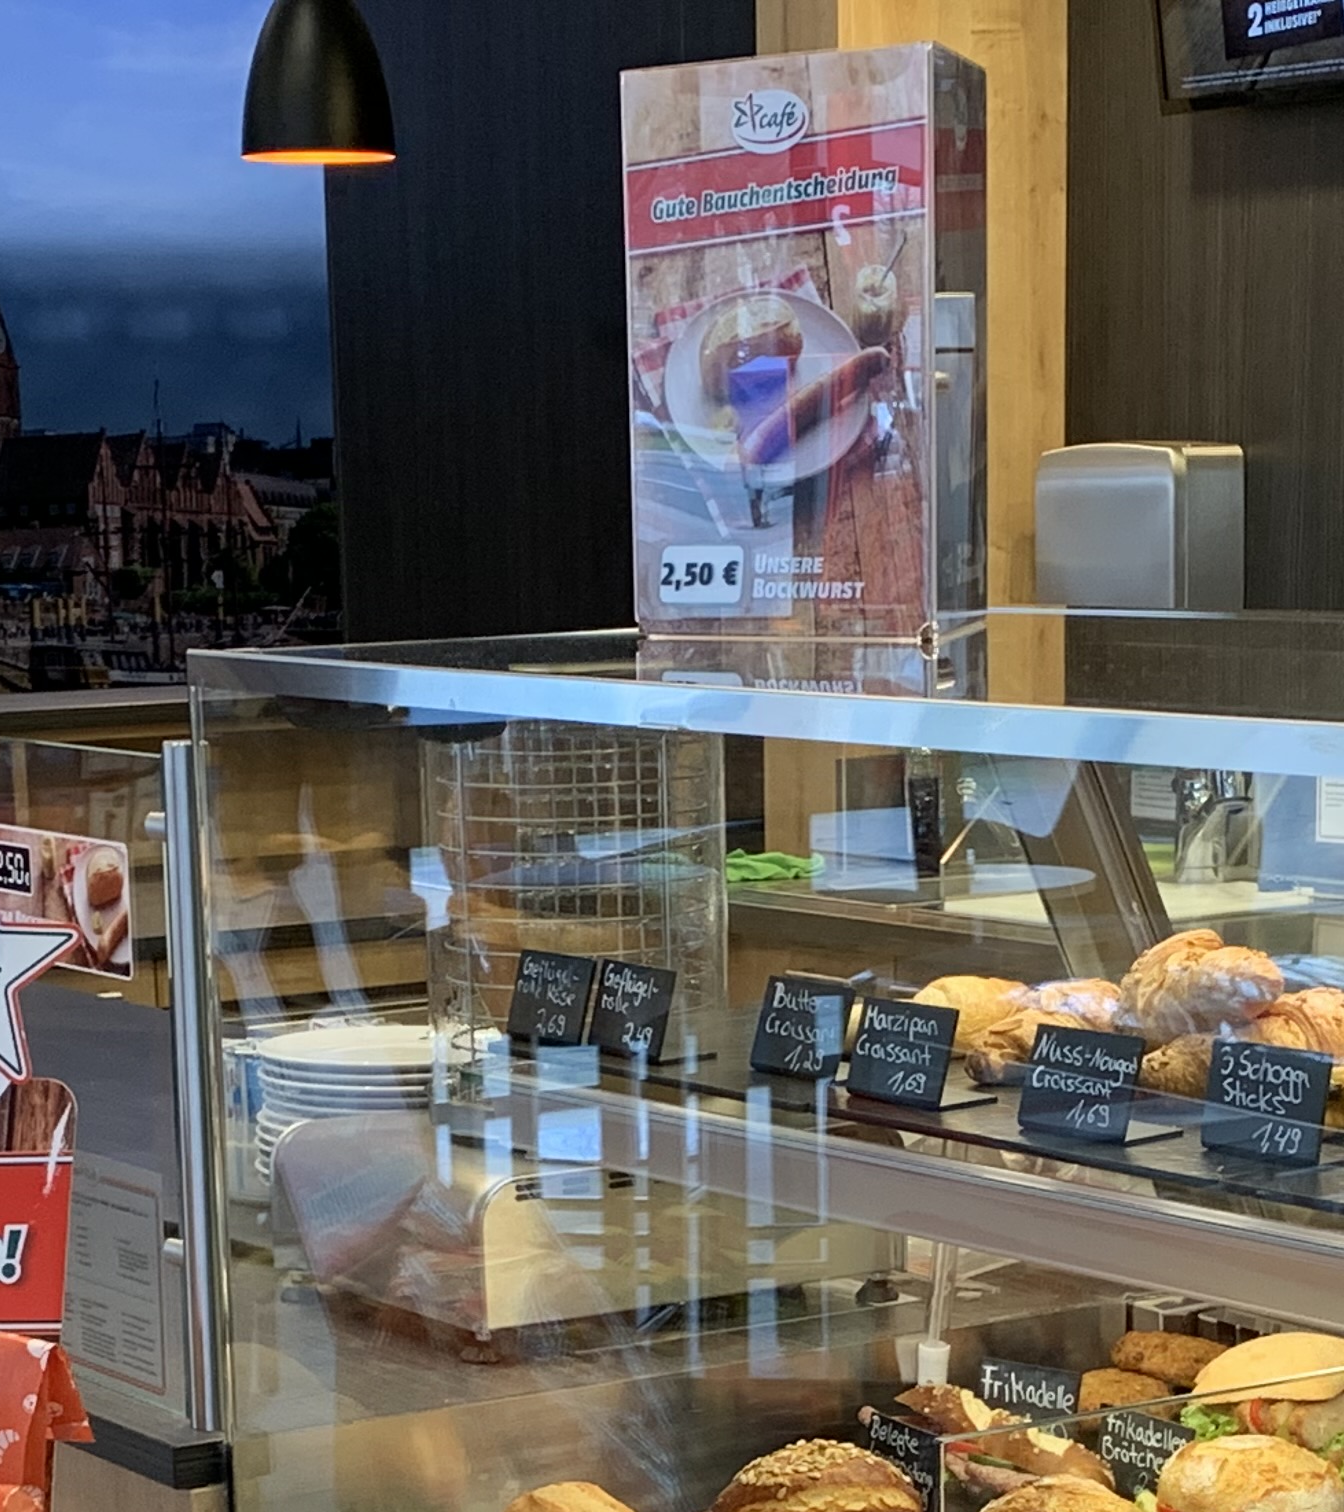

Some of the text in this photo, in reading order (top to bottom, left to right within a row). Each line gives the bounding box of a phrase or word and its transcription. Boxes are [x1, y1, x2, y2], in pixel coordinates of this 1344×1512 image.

[1248, 2, 1264, 38] 2
[759, 101, 798, 138] café
[652, 167, 898, 222] Gute Bauchentscheidung
[660, 560, 740, 591] 2,50 €
[754, 554, 825, 575] UNSERE
[752, 578, 865, 600] BOCKWURST
[603, 962, 660, 1008] Geflügel-
[601, 995, 630, 1016] rolle
[863, 1004, 939, 1042] Marzipan
[783, 1044, 824, 1072] 1,29
[855, 1033, 932, 1066] Croissant
[1220, 1045, 1235, 1075] 3
[887, 1070, 928, 1096] 1,69
[1032, 1064, 1113, 1100] Croissant
[1222, 1077, 1286, 1115] Sticks
[1065, 1099, 1110, 1130] 1,69
[1251, 1121, 1302, 1154] 1,49
[981, 1364, 1075, 1415] Frikadelle
[871, 1414, 920, 1456] Belegte
[1101, 1435, 1166, 1476] Brötche
